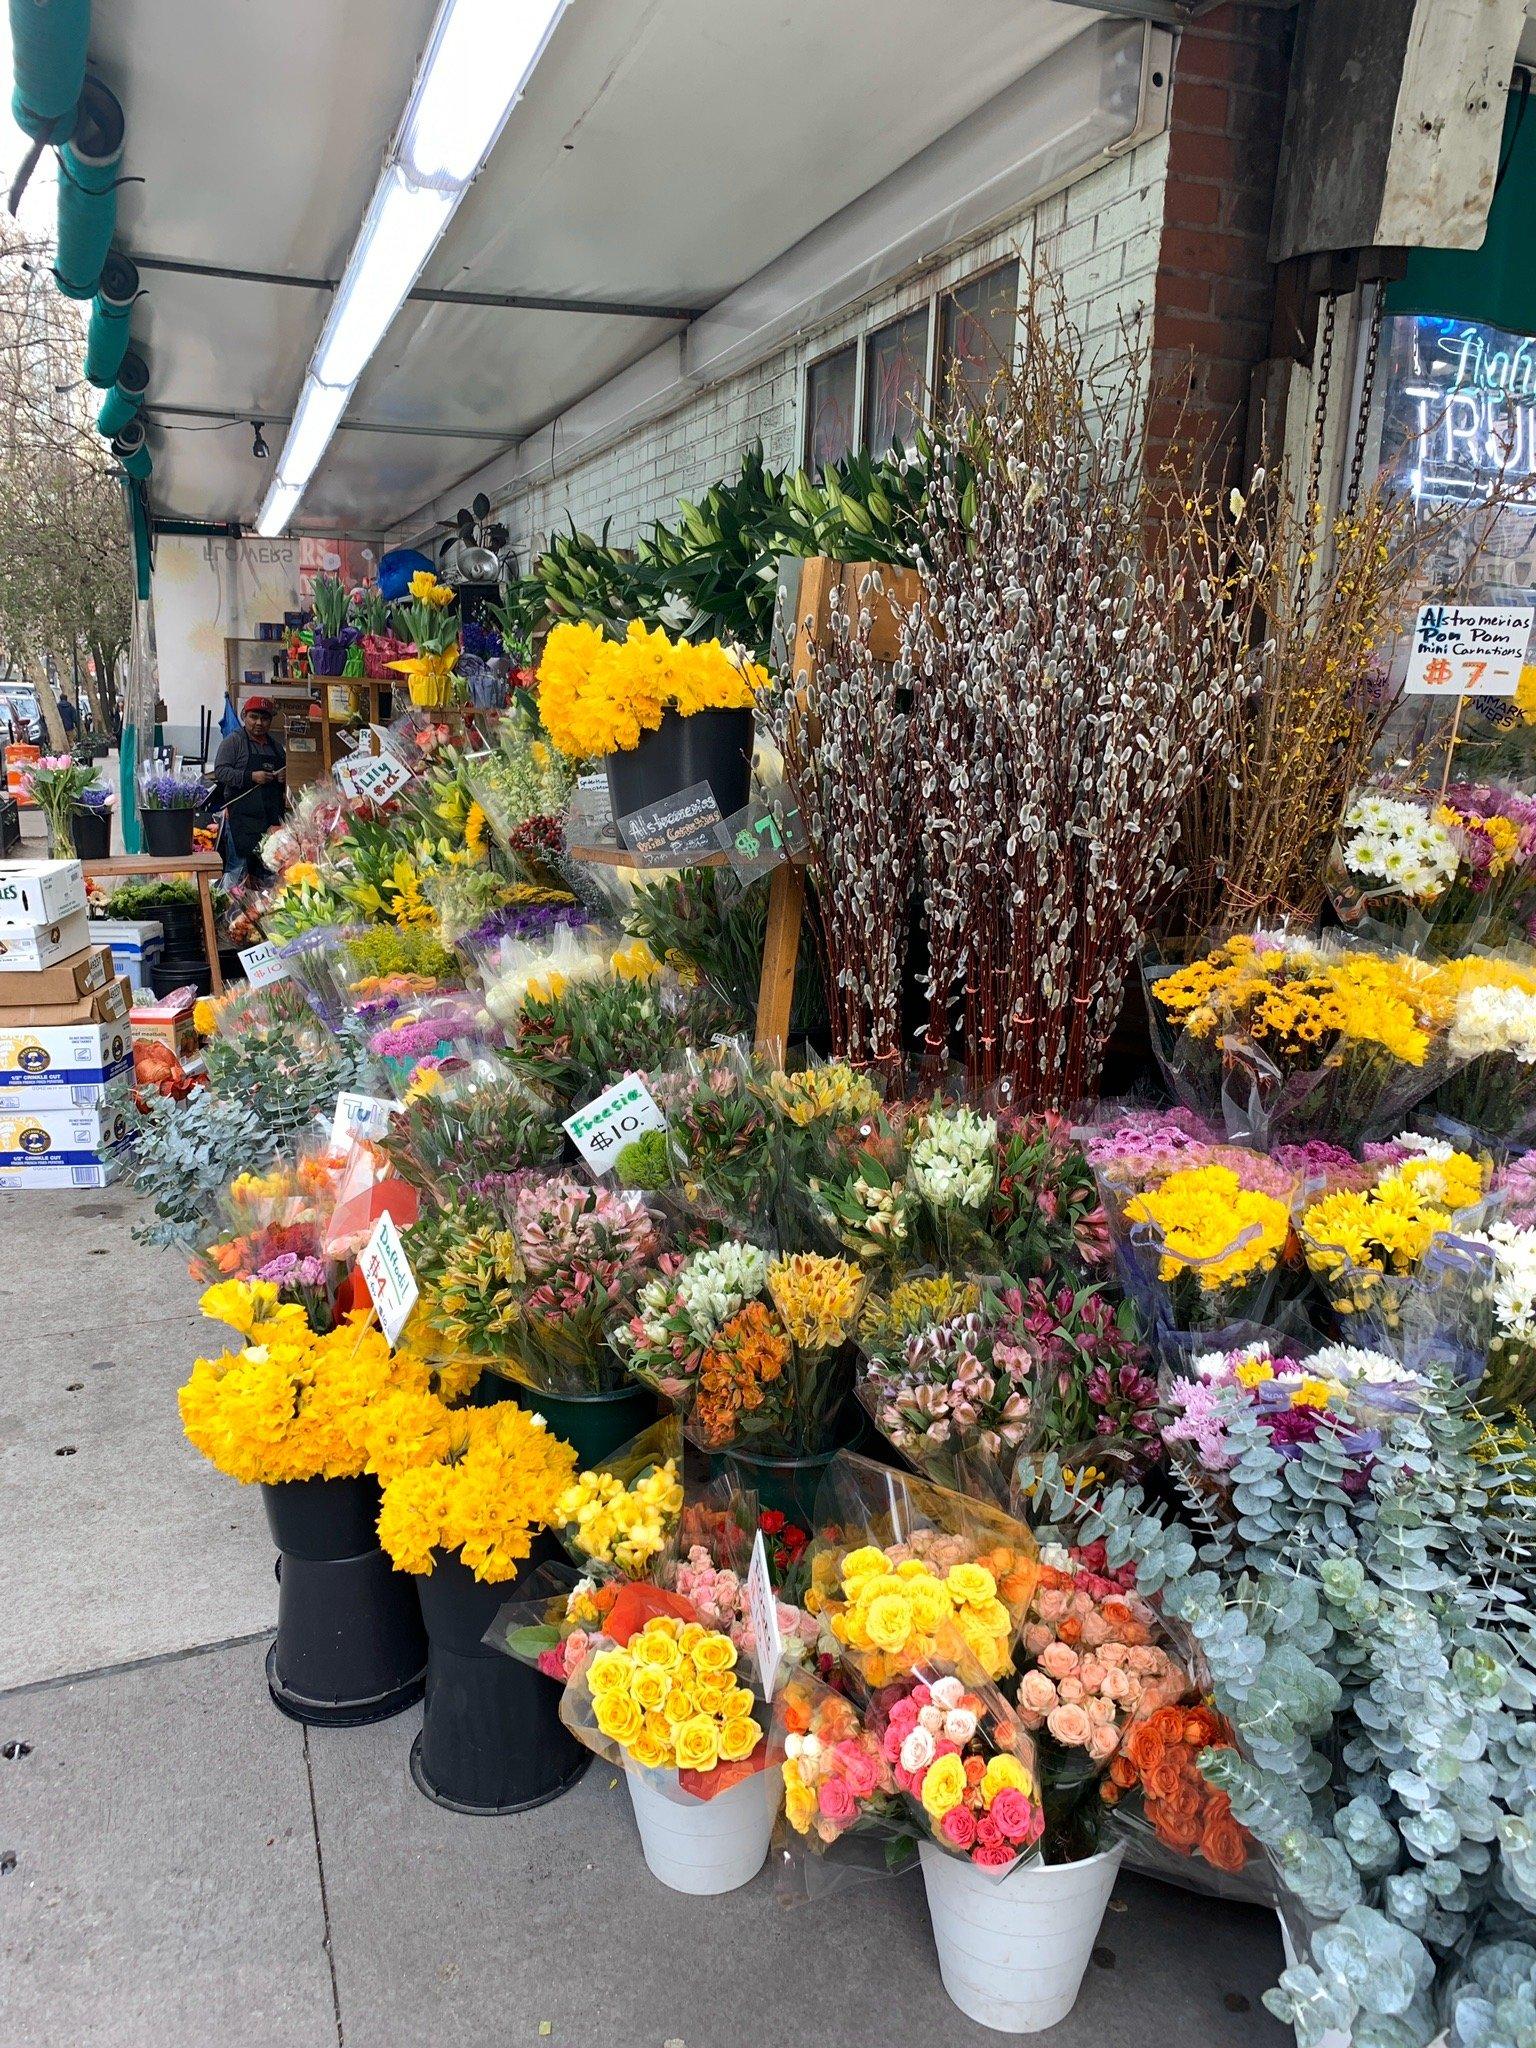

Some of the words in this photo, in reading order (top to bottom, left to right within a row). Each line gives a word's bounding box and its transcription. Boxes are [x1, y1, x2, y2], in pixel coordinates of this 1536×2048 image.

[1421, 607, 1530, 629] Alstromerias
[1470, 628, 1510, 643] Pom
[1418, 643, 1448, 655] mini
[1453, 643, 1523, 658] Carnations
[570, 1089, 643, 1139] Freesia
